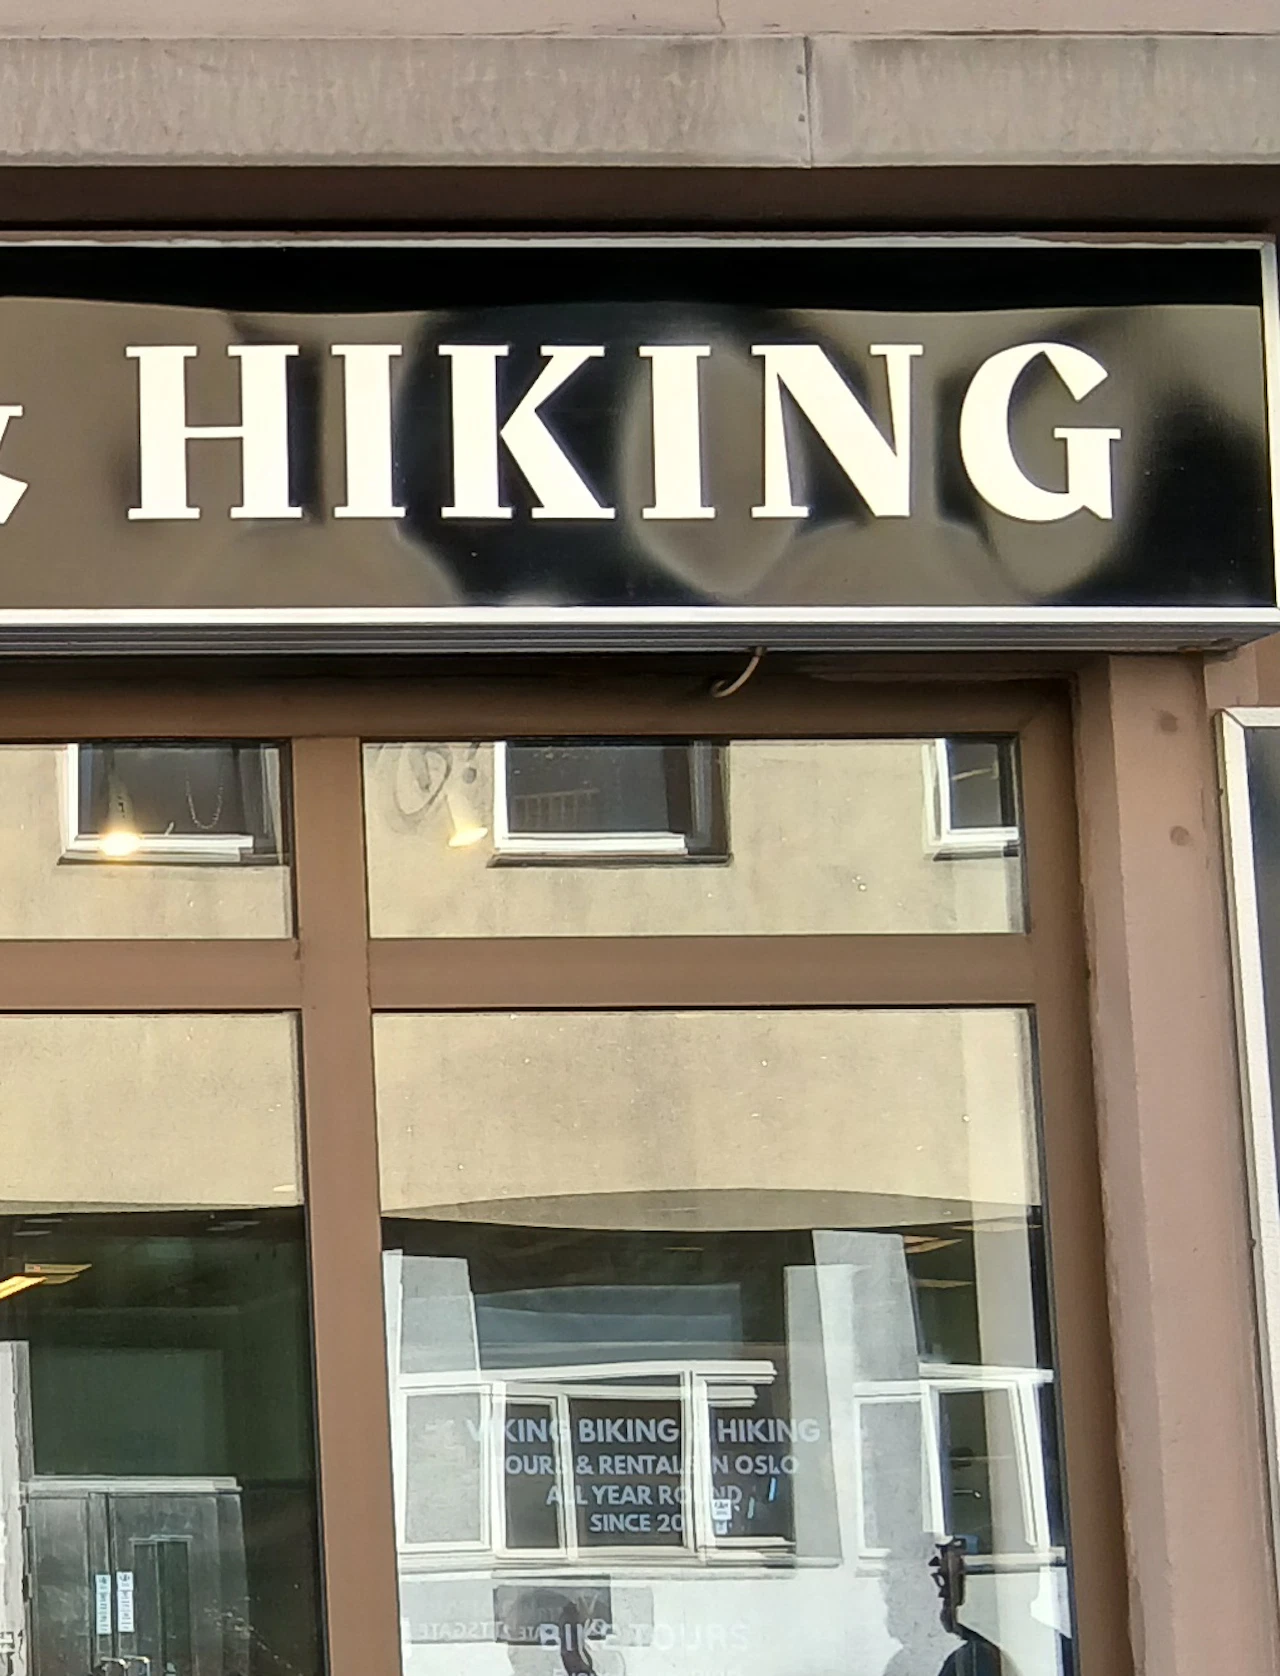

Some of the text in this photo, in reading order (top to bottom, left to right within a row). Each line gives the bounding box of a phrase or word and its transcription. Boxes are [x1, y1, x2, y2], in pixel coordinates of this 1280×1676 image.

[128, 344, 1121, 521] HIKING
[466, 1418, 821, 1443] VKING BIKING HIKING
[576, 1455, 594, 1475] &
[599, 1455, 696, 1475] RENTAL
[735, 1455, 799, 1475] OSLO
[591, 1485, 652, 1505] YEAR
[590, 1514, 650, 1533] SINCE
